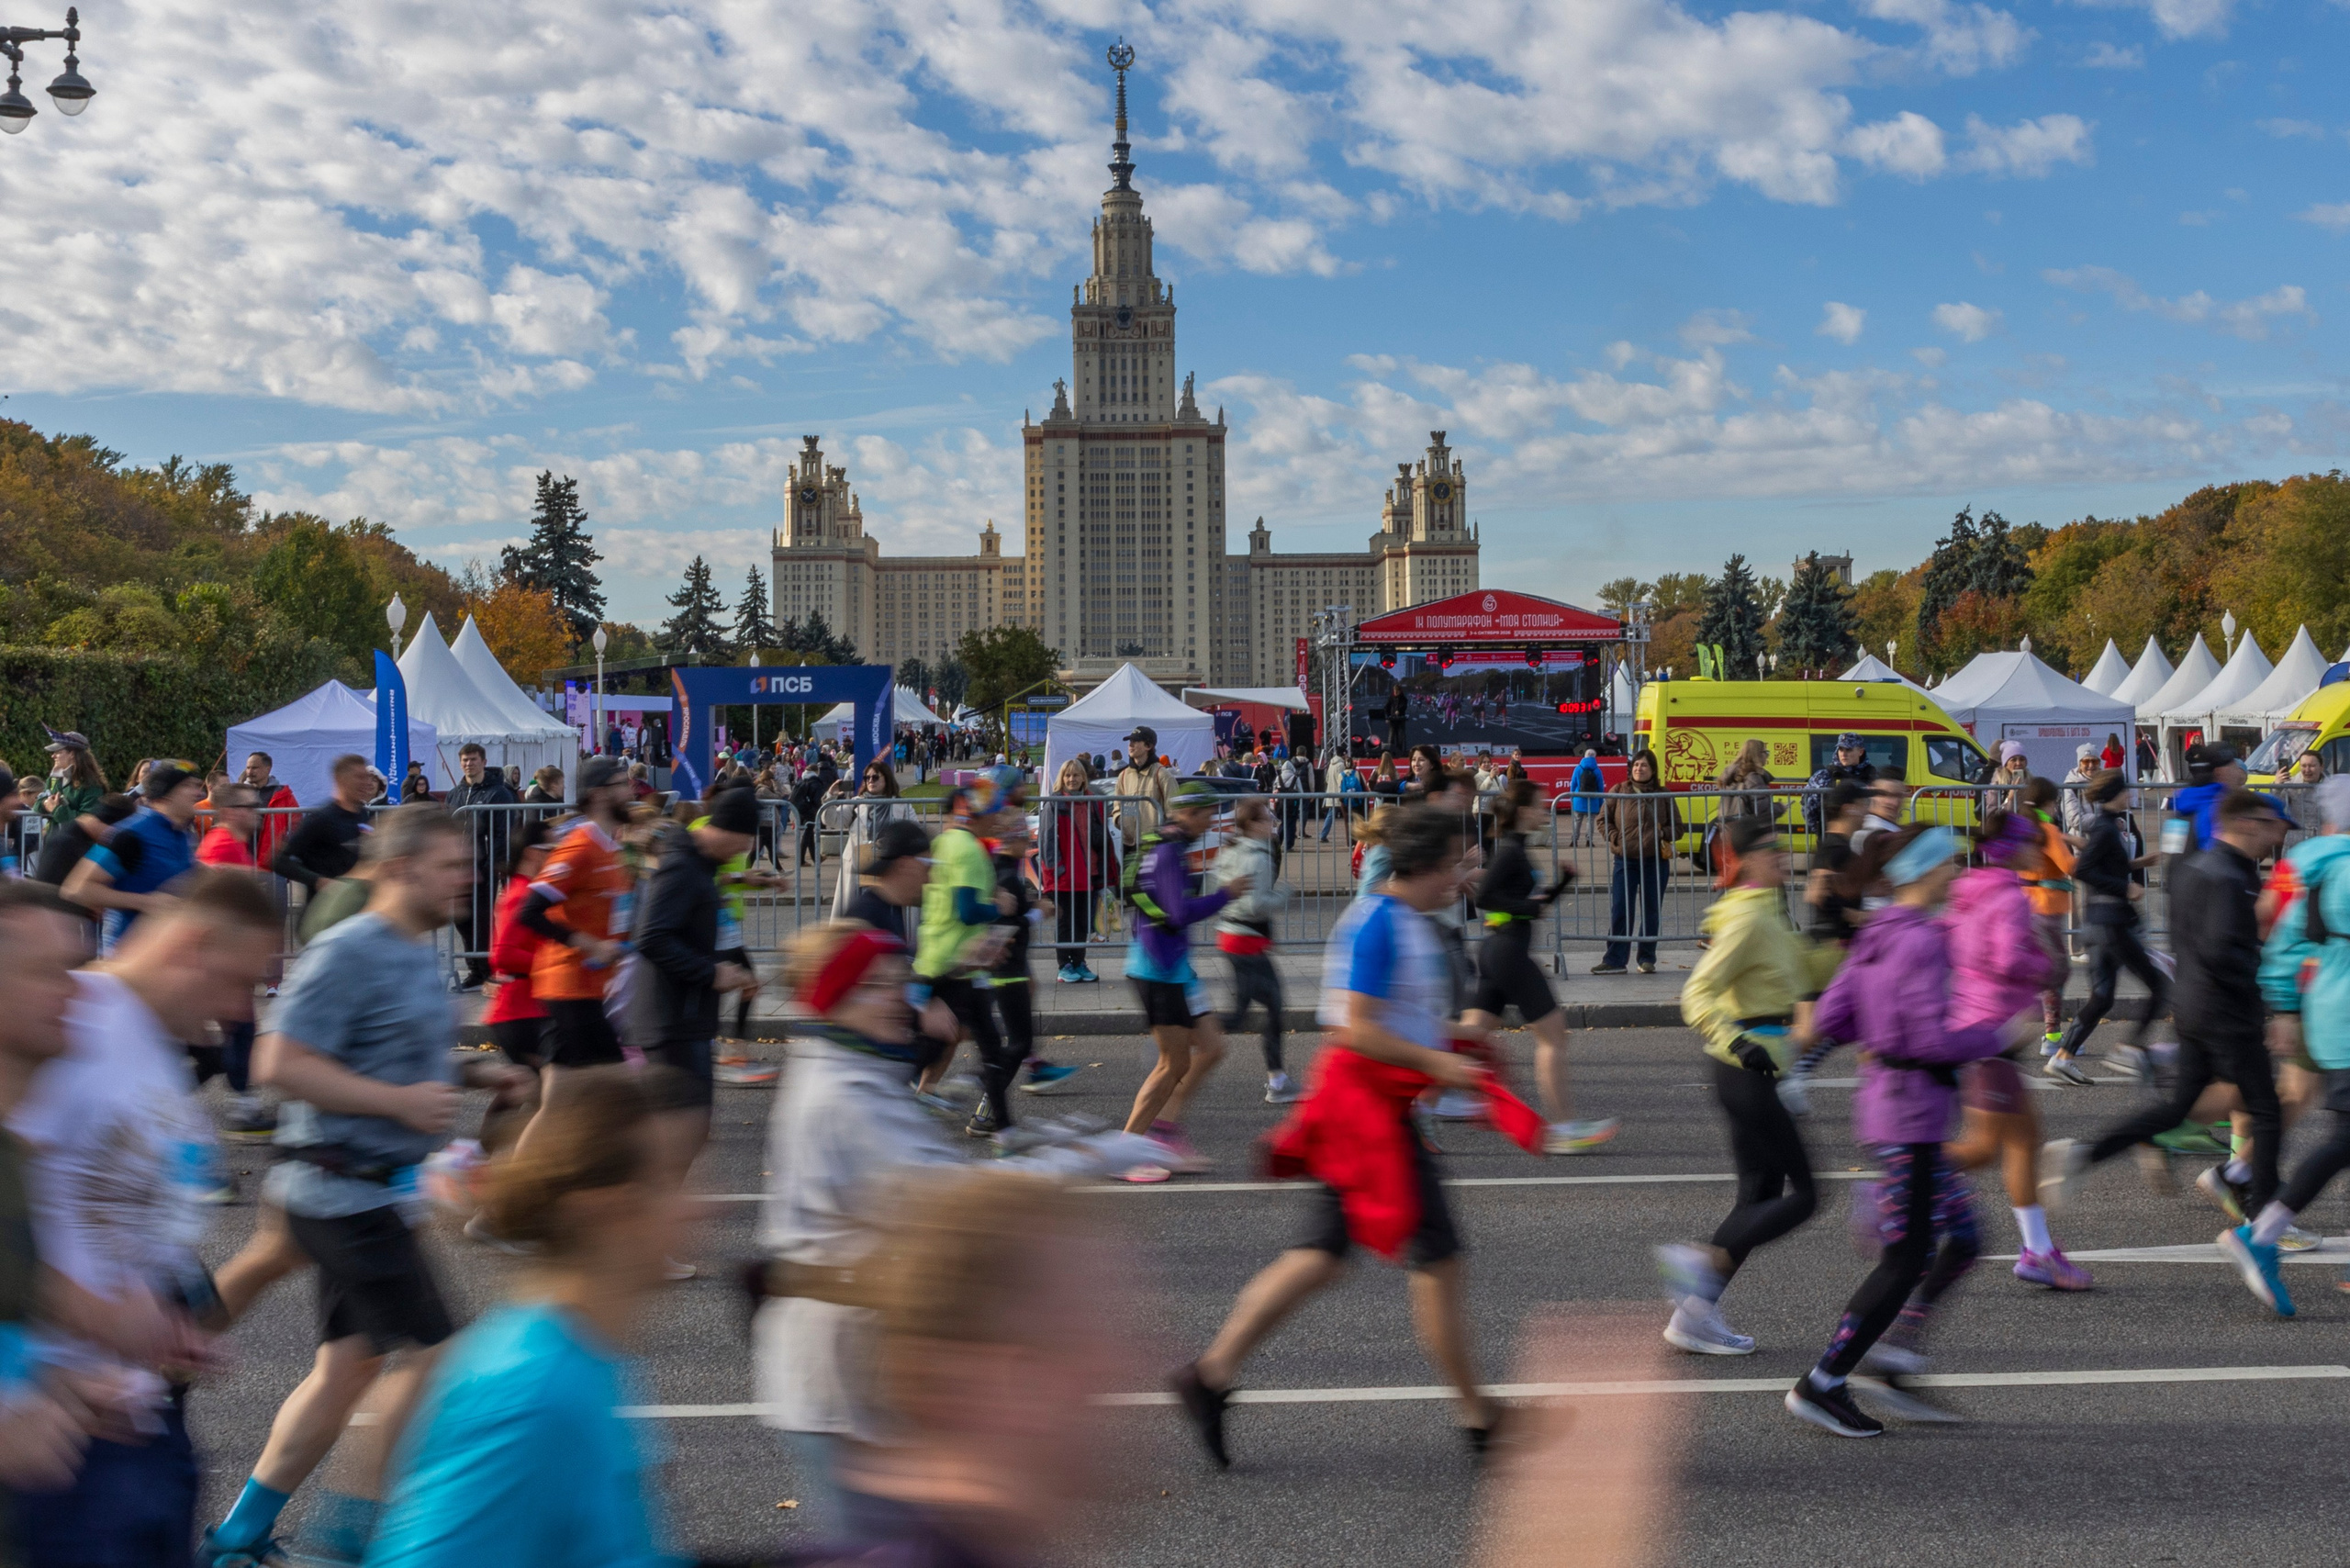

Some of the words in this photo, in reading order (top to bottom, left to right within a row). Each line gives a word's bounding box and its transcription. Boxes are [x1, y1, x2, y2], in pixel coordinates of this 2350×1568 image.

[1427, 615, 1492, 628] ПОЛУМАРАФОН
[1522, 614, 1564, 627] СТОЛИЦА»
[771, 677, 812, 693] ПСБ
[872, 712, 881, 745] МОСКВА
